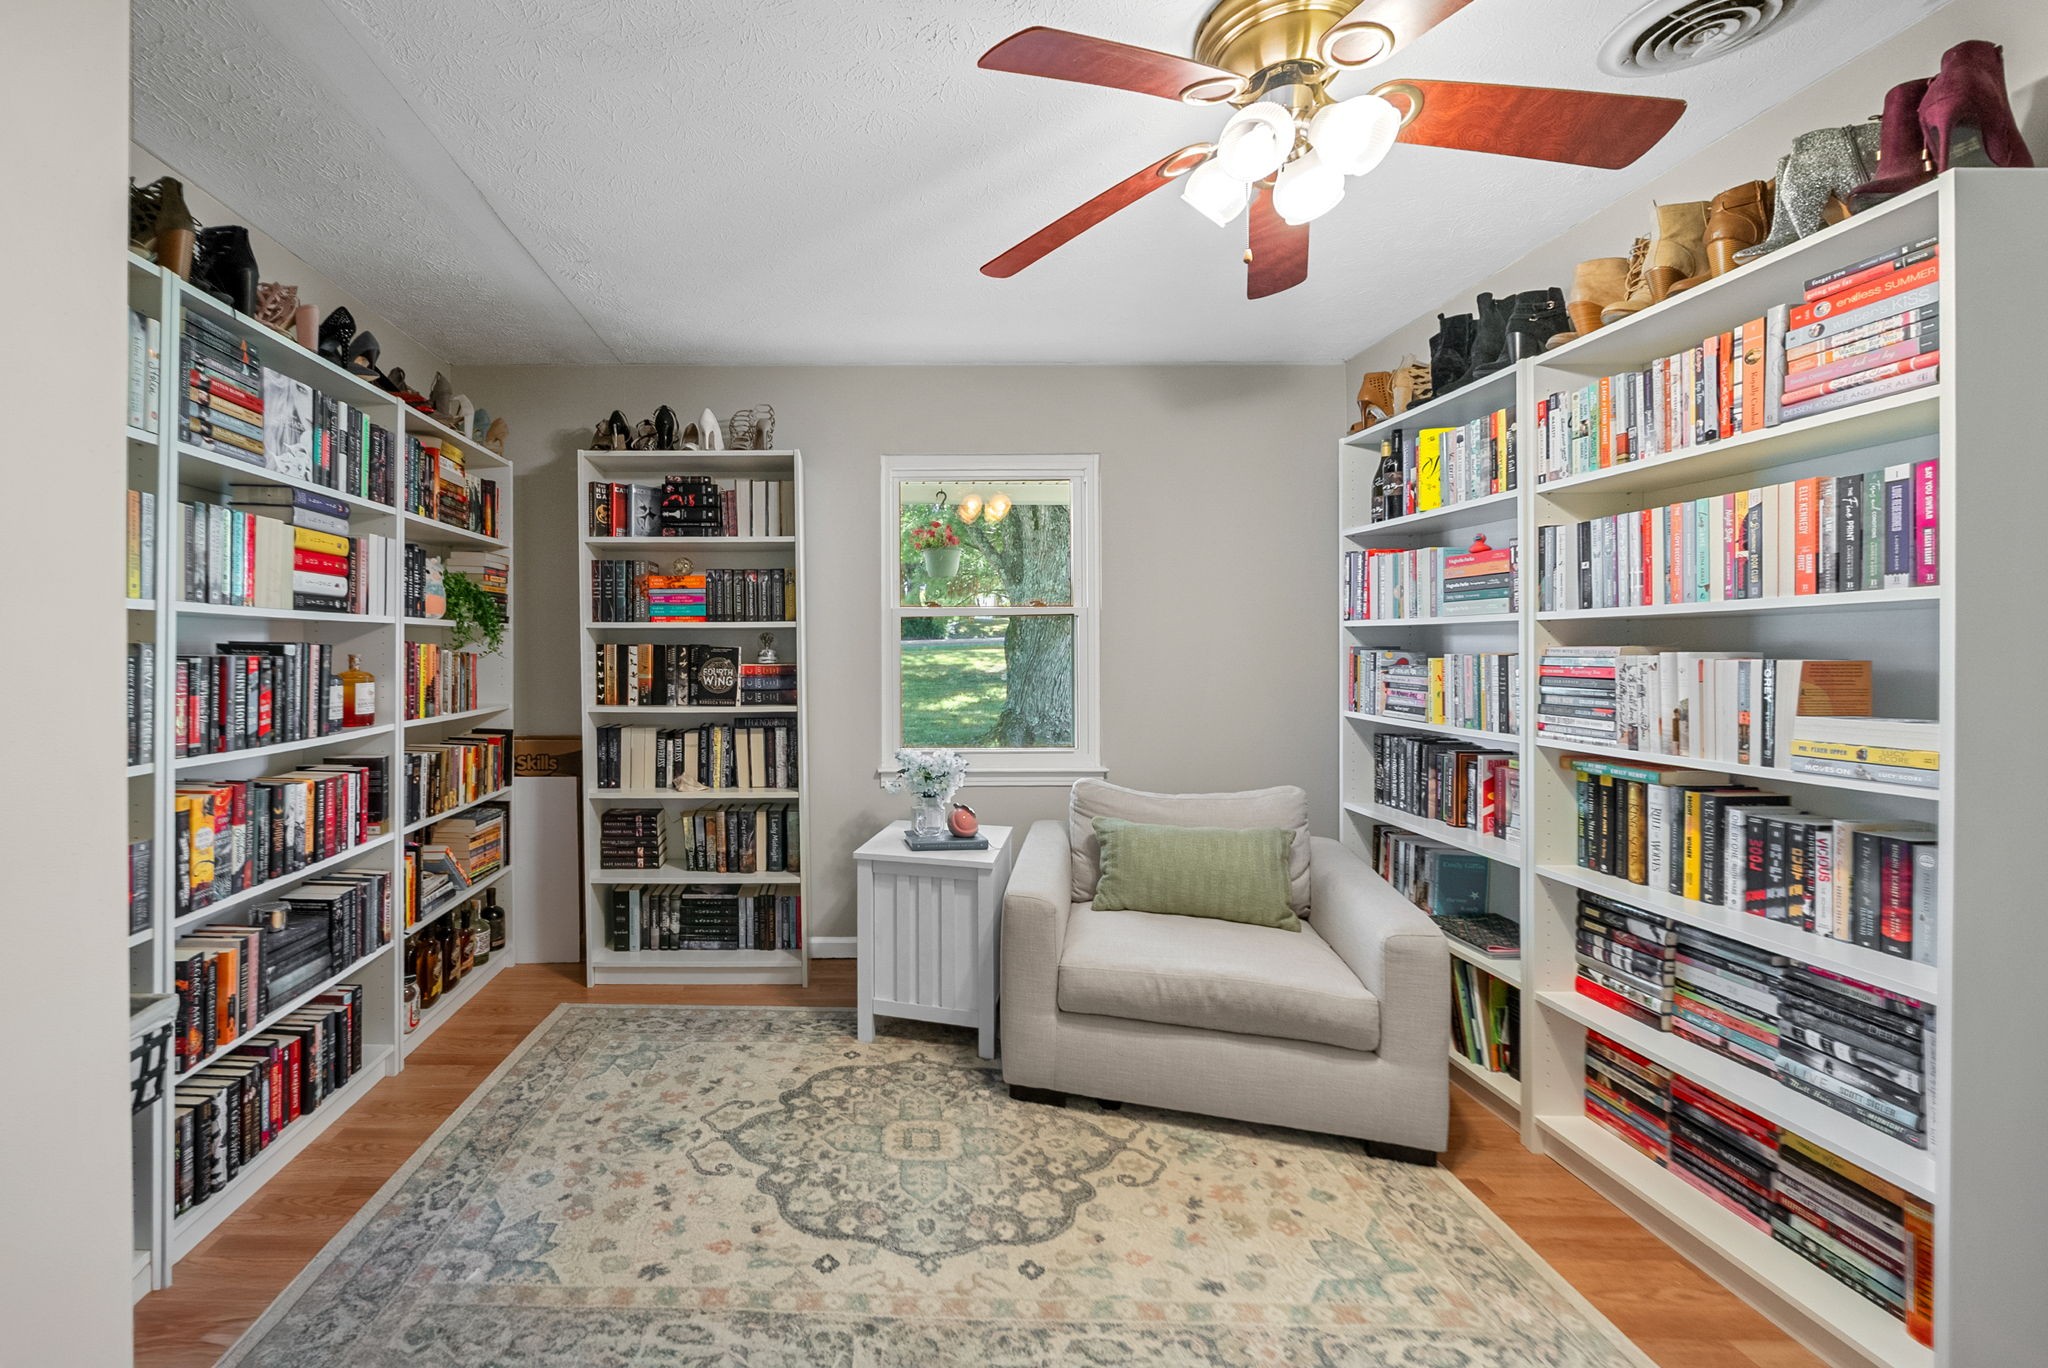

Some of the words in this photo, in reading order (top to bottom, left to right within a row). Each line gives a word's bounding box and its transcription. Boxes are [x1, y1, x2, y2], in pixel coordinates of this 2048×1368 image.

[1812, 275, 1832, 285] forget
[1836, 287, 1881, 307] endless
[1885, 267, 1936, 291] SUMMER
[1892, 289, 1931, 310] KISS
[148, 361, 160, 396] Stolen
[1750, 371, 1758, 396] Royally
[1852, 389, 1870, 398] AND
[1873, 382, 1893, 393] FOR
[1895, 377, 1912, 388] ALL
[1924, 466, 1933, 479] SAY
[1799, 486, 1809, 502] ELLE
[1891, 485, 1902, 499] LOVE
[1925, 480, 1933, 494] YOU
[1842, 496, 1859, 518] Fine
[1871, 499, 1881, 510] and
[1891, 499, 1902, 532] REDESIGNED
[1925, 496, 1933, 520] SWEAR
[1724, 509, 1732, 526] Night
[1799, 503, 1809, 534] KENNEDY
[1724, 528, 1733, 543] Shift
[1846, 520, 1854, 541] PRINT
[1751, 570, 1759, 582] CLUB
[144, 649, 153, 688] CHEVY
[703, 668, 733, 676] FOURTH
[214, 676, 220, 685] OF
[214, 686, 219, 694] US
[235, 673, 246, 702] NINTH
[703, 676, 734, 686] WING
[1764, 669, 1772, 702] GREY
[143, 698, 153, 750] STEVENS
[235, 705, 246, 735] HOUSE
[657, 738, 666, 767] POWERLESS
[674, 738, 682, 762] RECKLESS
[517, 755, 557, 770] Skills
[1611, 768, 1627, 776] EMILY
[1628, 770, 1648, 779] HENRY
[1898, 774, 1922, 782] SCORE
[1629, 803, 1639, 828] KING
[1650, 807, 1662, 831] RULE
[1704, 800, 1714, 817] V.E.
[1704, 818, 1715, 861] SCHWAB
[1732, 832, 1739, 841] BY
[1629, 837, 1639, 866] SCARS
[1651, 840, 1661, 872] WOLVES
[1816, 838, 1829, 882] VICIOUS
[1891, 844, 1899, 868] BENEATH
[192, 957, 201, 995] LEGACY
[192, 1006, 200, 1026] ASH
[207, 983, 216, 1041] INCENDIARY
[1867, 1023, 1899, 1042] DEEP
[1784, 1055, 1829, 1088] ALIVE
